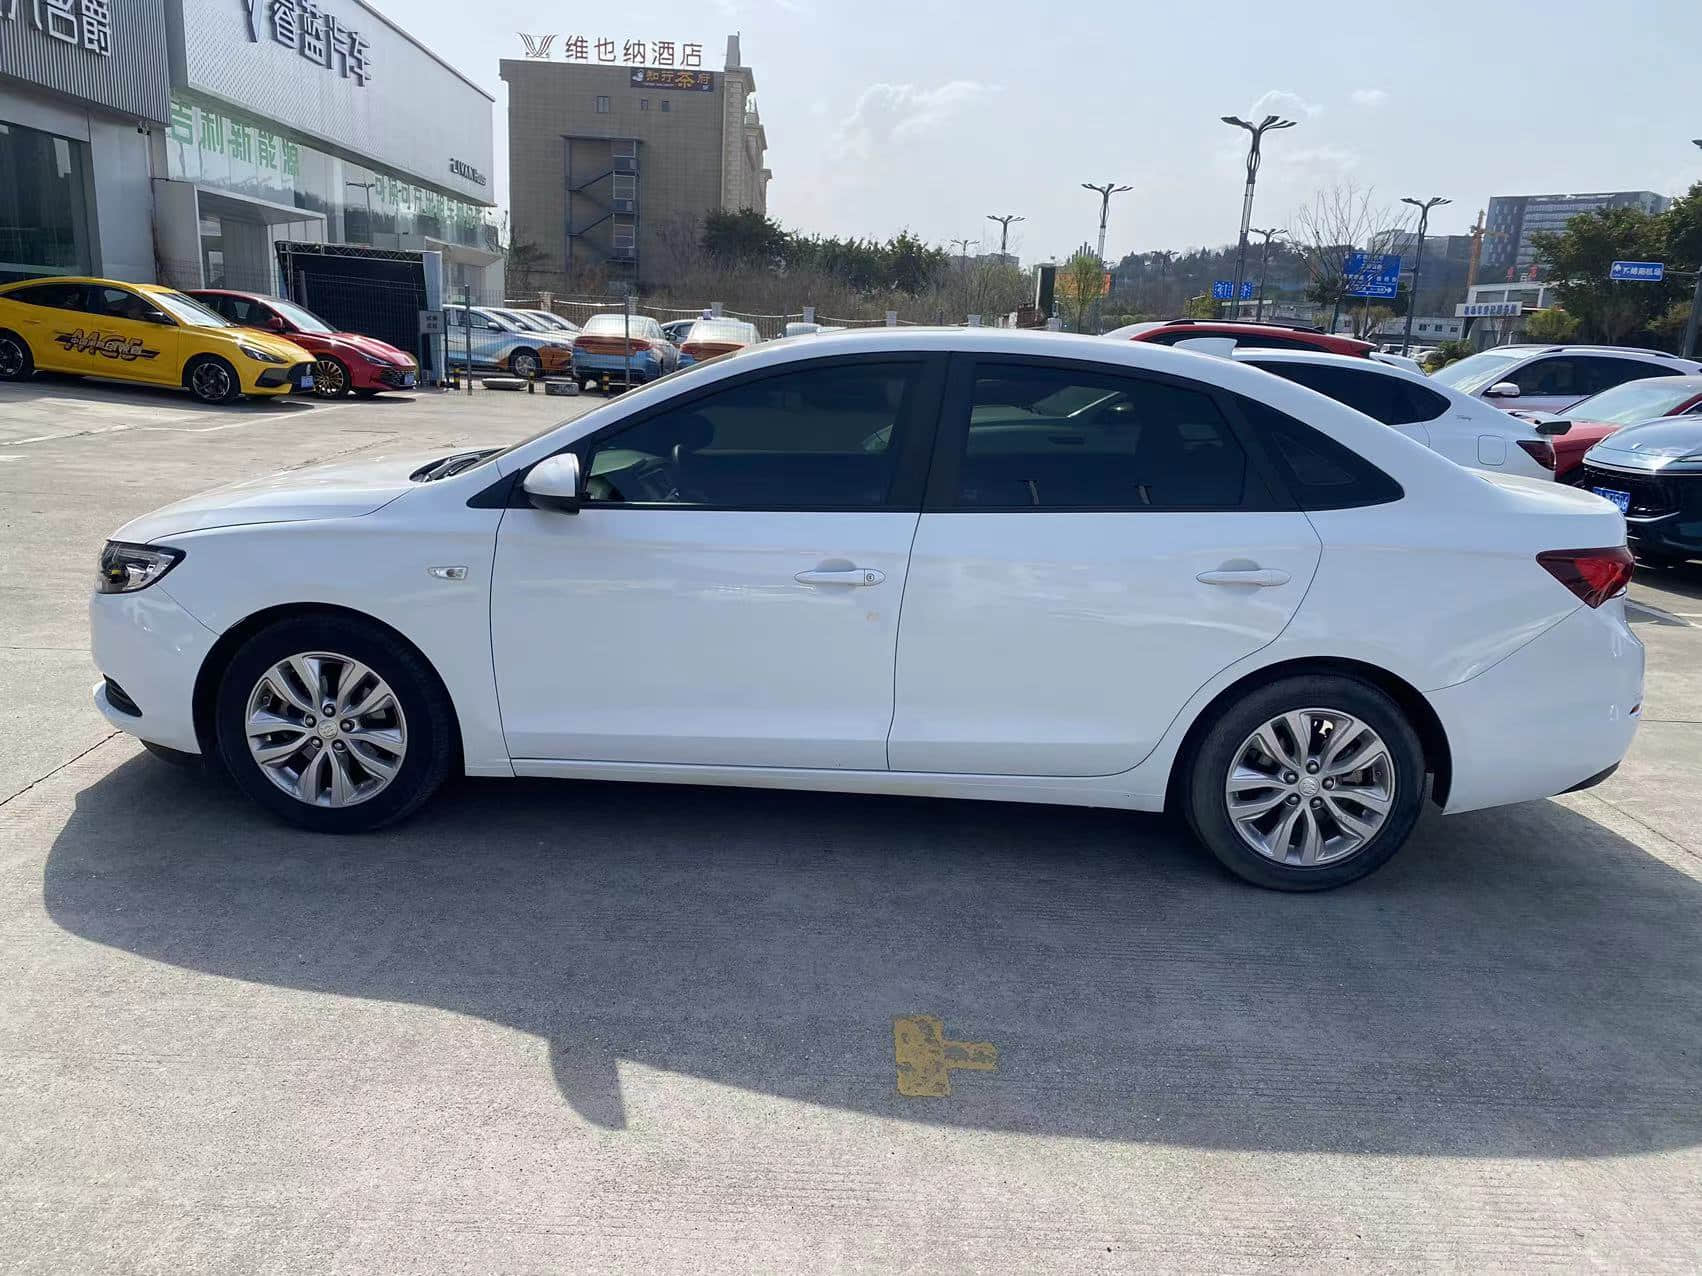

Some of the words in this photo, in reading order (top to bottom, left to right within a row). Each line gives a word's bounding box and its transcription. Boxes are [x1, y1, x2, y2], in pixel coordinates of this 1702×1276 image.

[565, 35, 703, 67] 维也纳酒店
[171, 101, 299, 177] 吉利新能源
